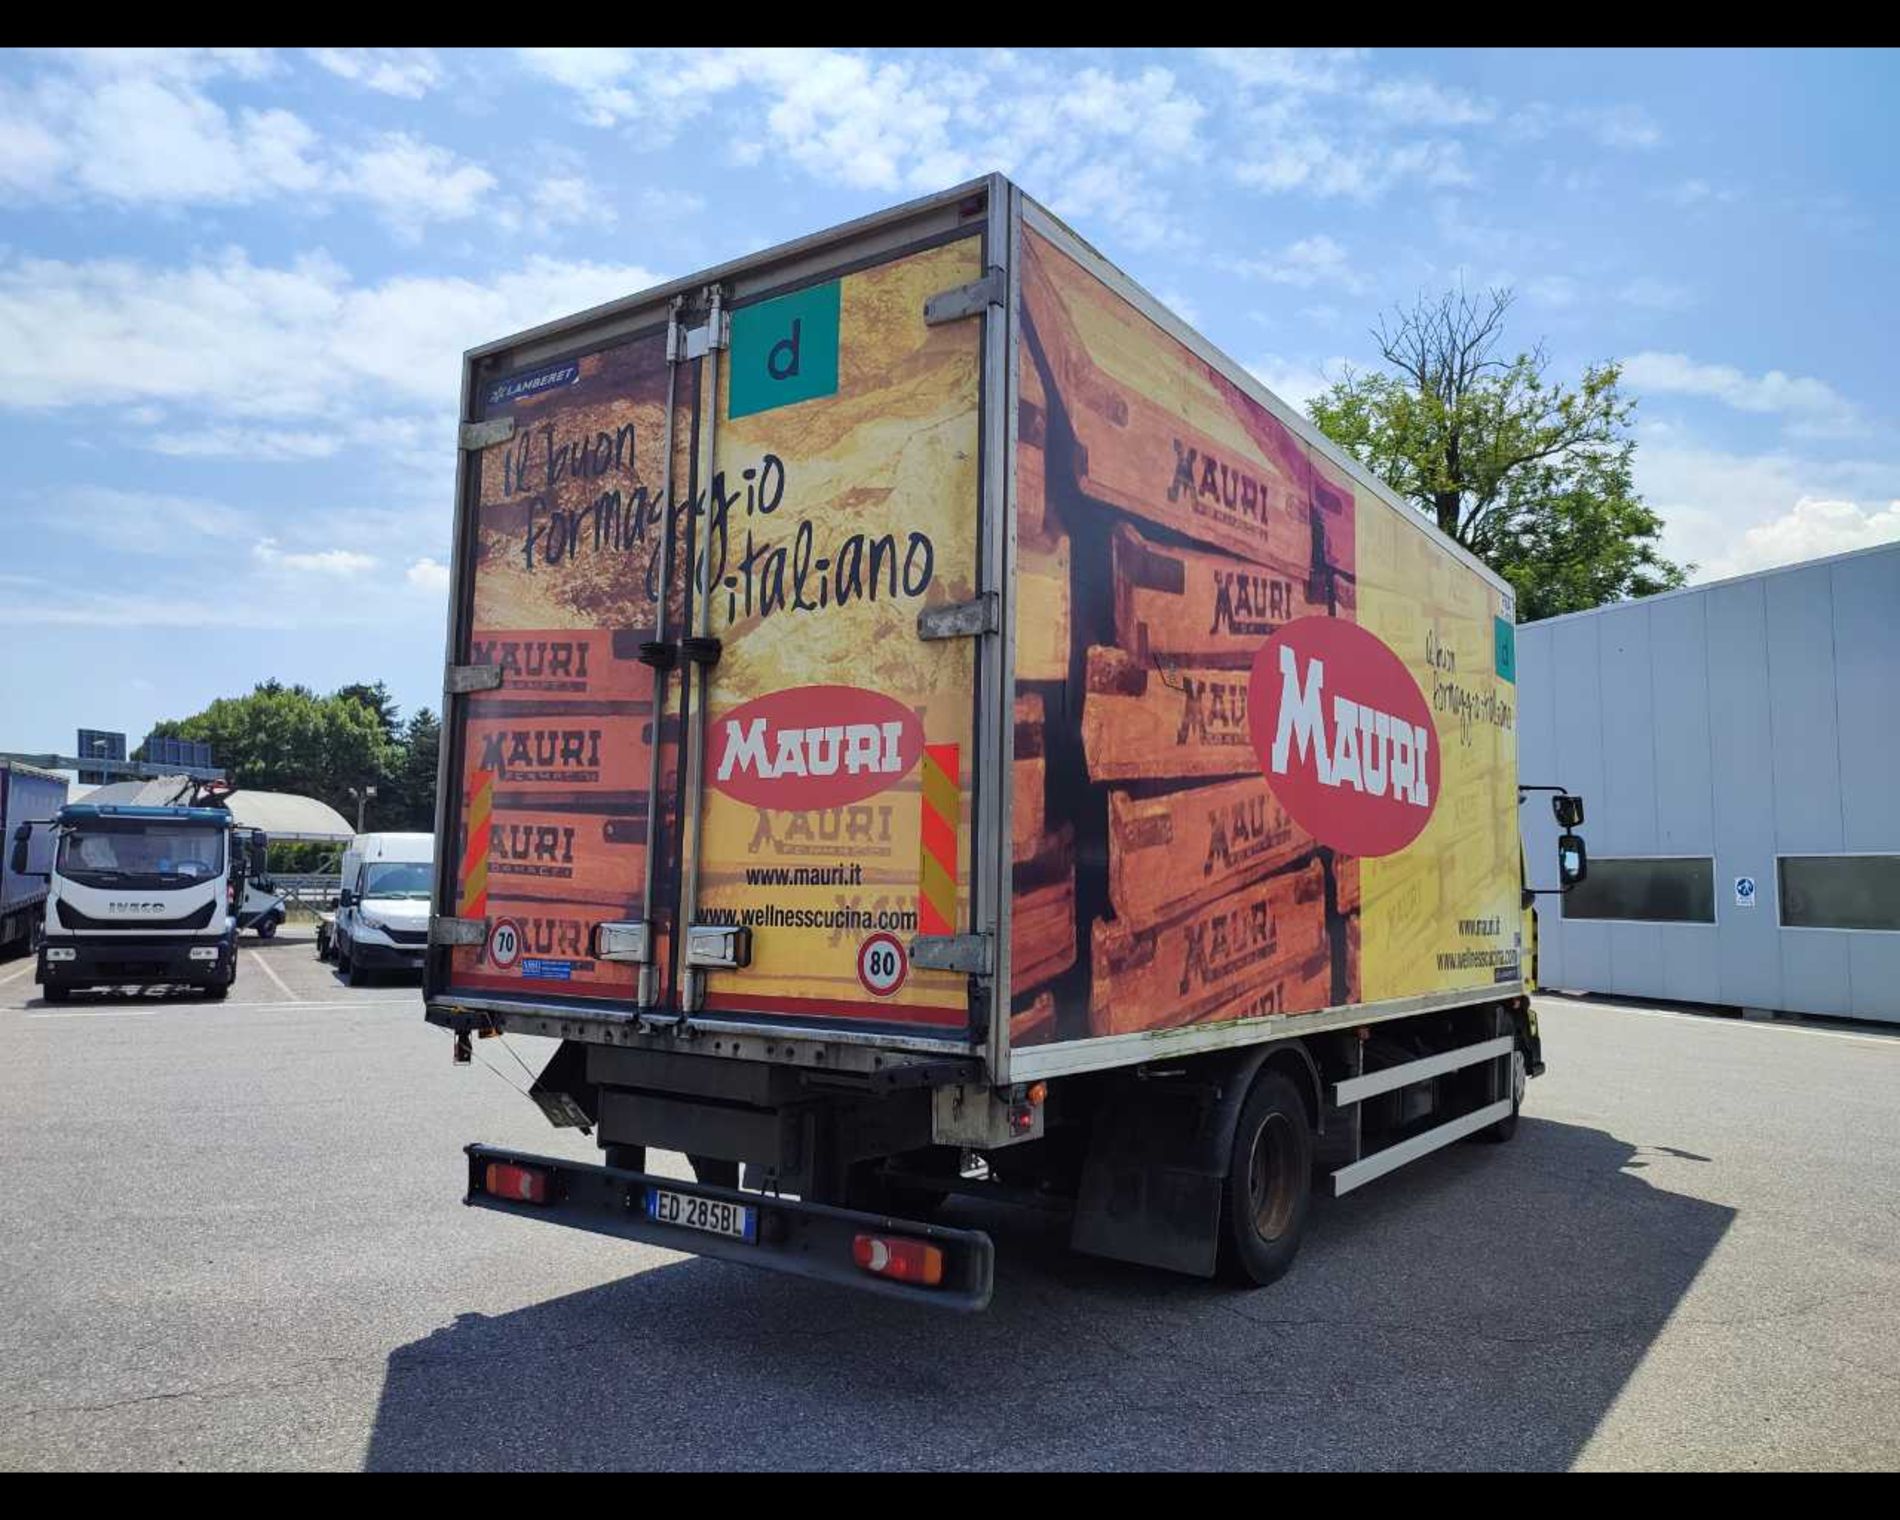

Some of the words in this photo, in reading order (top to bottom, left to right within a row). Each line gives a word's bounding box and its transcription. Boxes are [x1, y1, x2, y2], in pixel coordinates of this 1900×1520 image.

[768, 318, 800, 380] d
[506, 367, 575, 396] LAMBERET
[543, 422, 637, 487] buon
[1167, 438, 1269, 526] MAURI
[723, 519, 935, 627] italiano
[1209, 569, 1292, 635] MAURI
[716, 717, 904, 781] MAURI
[1271, 643, 1429, 808] MAURI
[479, 730, 602, 782] MAURI
[487, 822, 575, 863] AURI
[745, 863, 862, 886] www.mauri.it
[109, 902, 165, 913] IVECO
[497, 932, 514, 953] 70
[869, 950, 896, 977] 80
[1179, 899, 1277, 997] MAURI
[658, 1193, 680, 1221] ED
[686, 1199, 742, 1236] 285BL
